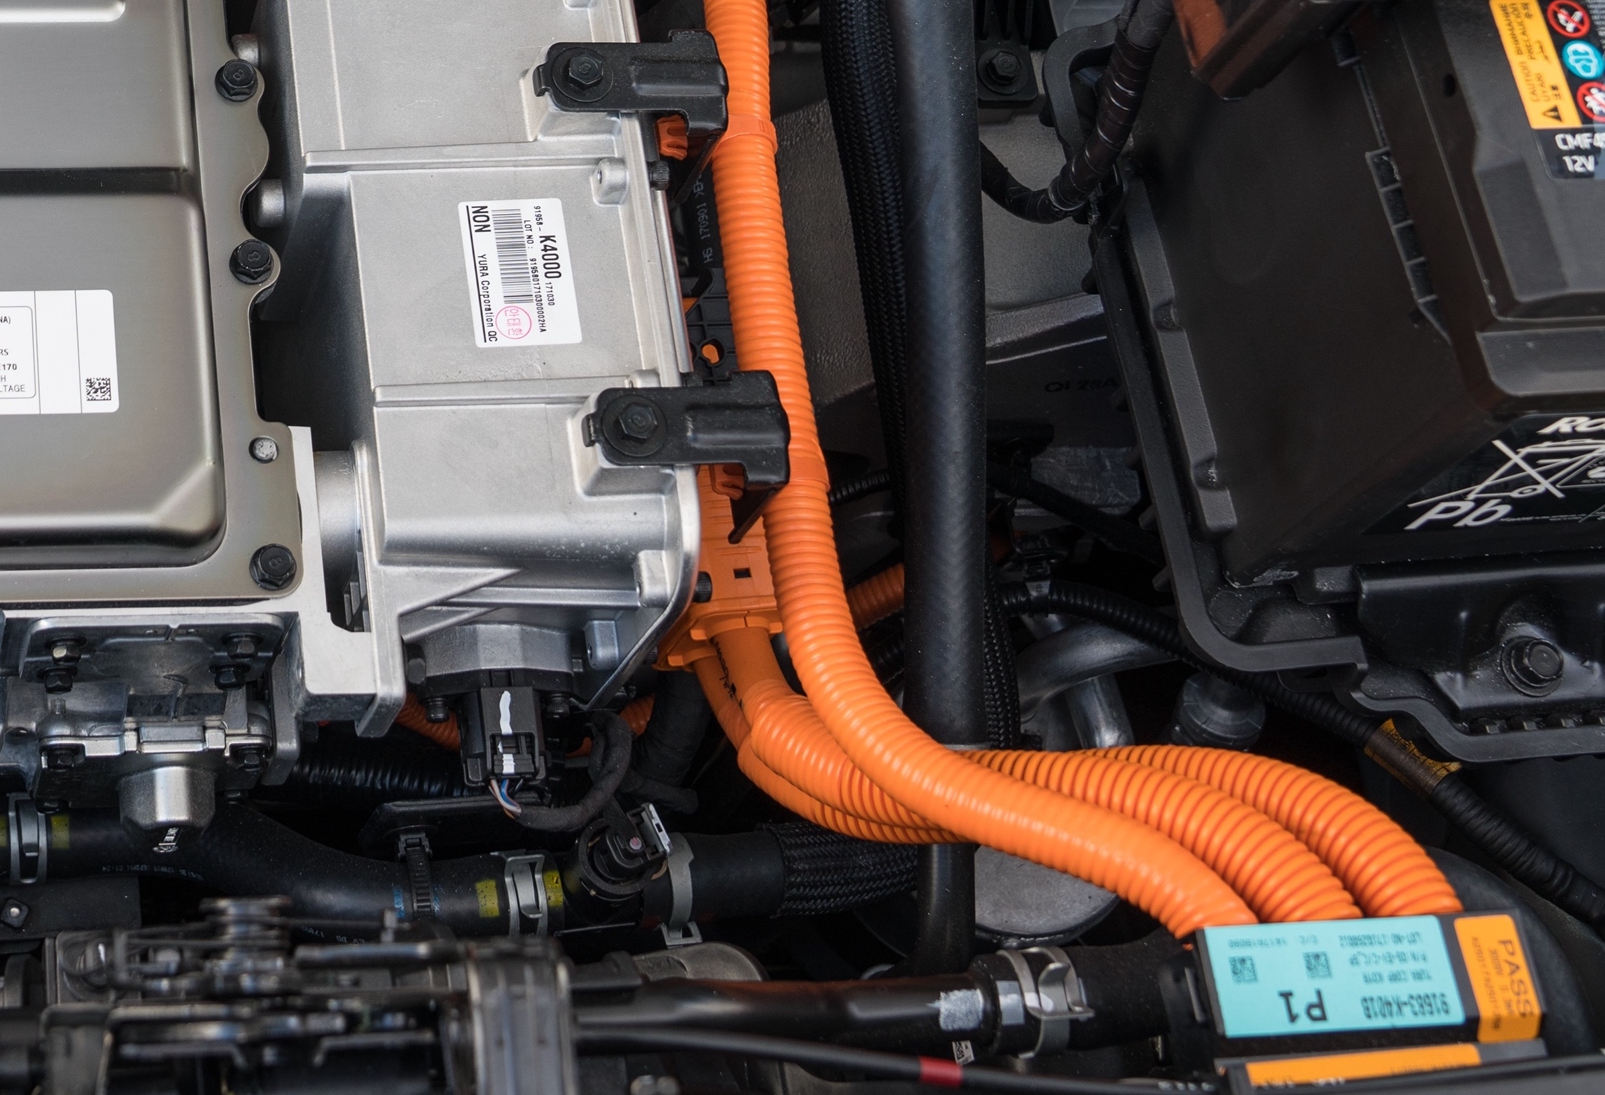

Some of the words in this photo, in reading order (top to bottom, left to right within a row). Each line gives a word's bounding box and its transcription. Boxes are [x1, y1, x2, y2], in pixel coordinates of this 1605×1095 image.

[1562, 154, 1595, 173] 12V
[471, 205, 492, 234] NON
[524, 219, 533, 232] LOT
[696, 202, 711, 240] 170901
[477, 253, 489, 278] YURA
[539, 235, 562, 280] K4000
[480, 280, 495, 328] Corporation
[545, 281, 555, 306] 171030
[487, 330, 498, 342] QC
[1403, 498, 1514, 531] Pb
[1498, 938, 1535, 1020] PASS
[1277, 988, 1328, 1024] P1
